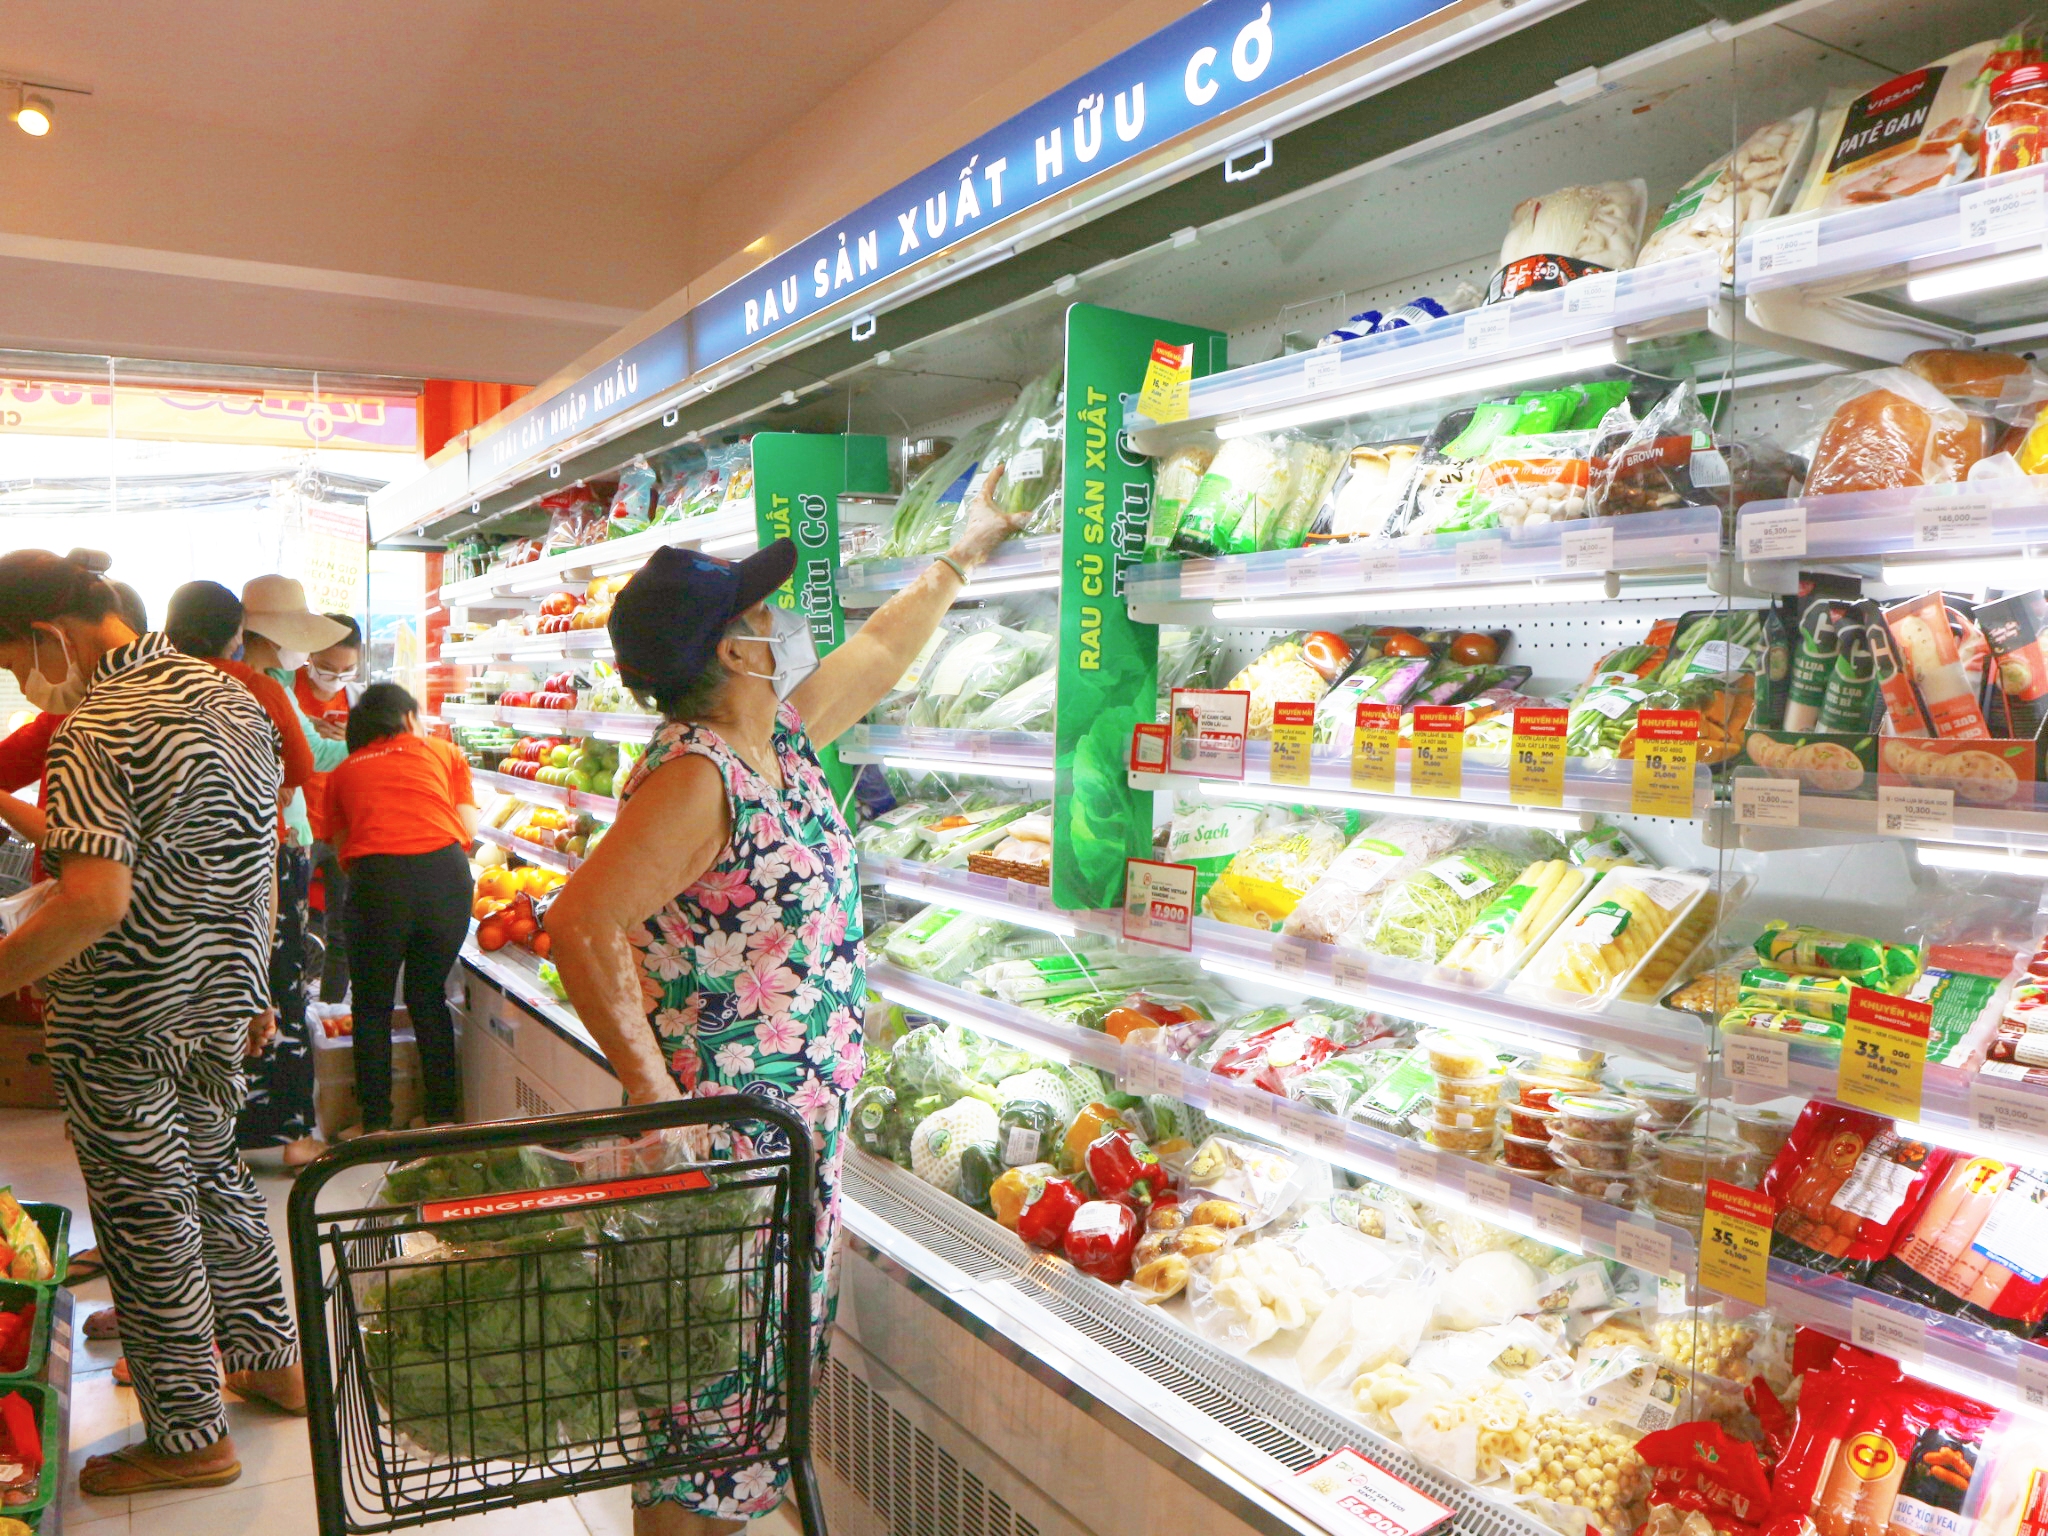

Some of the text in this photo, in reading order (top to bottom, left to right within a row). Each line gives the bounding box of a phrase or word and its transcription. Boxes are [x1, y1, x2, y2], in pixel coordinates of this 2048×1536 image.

[1866, 80, 1926, 111] VISSAN
[1883, 105, 1928, 138] GAN
[743, 1, 1274, 335] RAU SẢN XUẤT HỮU CƠ
[1989, 200, 2020, 214] 99,000
[492, 358, 639, 465] TRÁI CÂY NHẬP KHẨU
[1626, 447, 1664, 467] BROWN
[766, 493, 791, 541] UẤT
[798, 493, 829, 548] Cơ
[1076, 385, 1108, 671] RAU CỦ SẢN XUẤT
[800, 557, 835, 645] Hữu
[1420, 711, 1448, 721] KHUYẾN
[1520, 715, 1568, 725] KHUYẾN MÃI
[1641, 717, 1697, 728] KHUYẾN MÃI
[1194, 823, 1230, 844] Sạch
[1154, 904, 1185, 921] 7.900
[1859, 1000, 1931, 1024] KHUYẾN MÃI
[1874, 1014, 1911, 1028] PROMOTION
[1854, 1040, 1910, 1063] 33, 000
[1993, 1105, 2028, 1120] 103,000
[1711, 1190, 1772, 1215] KHUYẾN MÃI
[1744, 1237, 1759, 1247] 000
[1853, 1443, 1889, 1468] CP
[1896, 1500, 1912, 1516] XÚC
[1915, 1507, 1935, 1524] XÍCH
